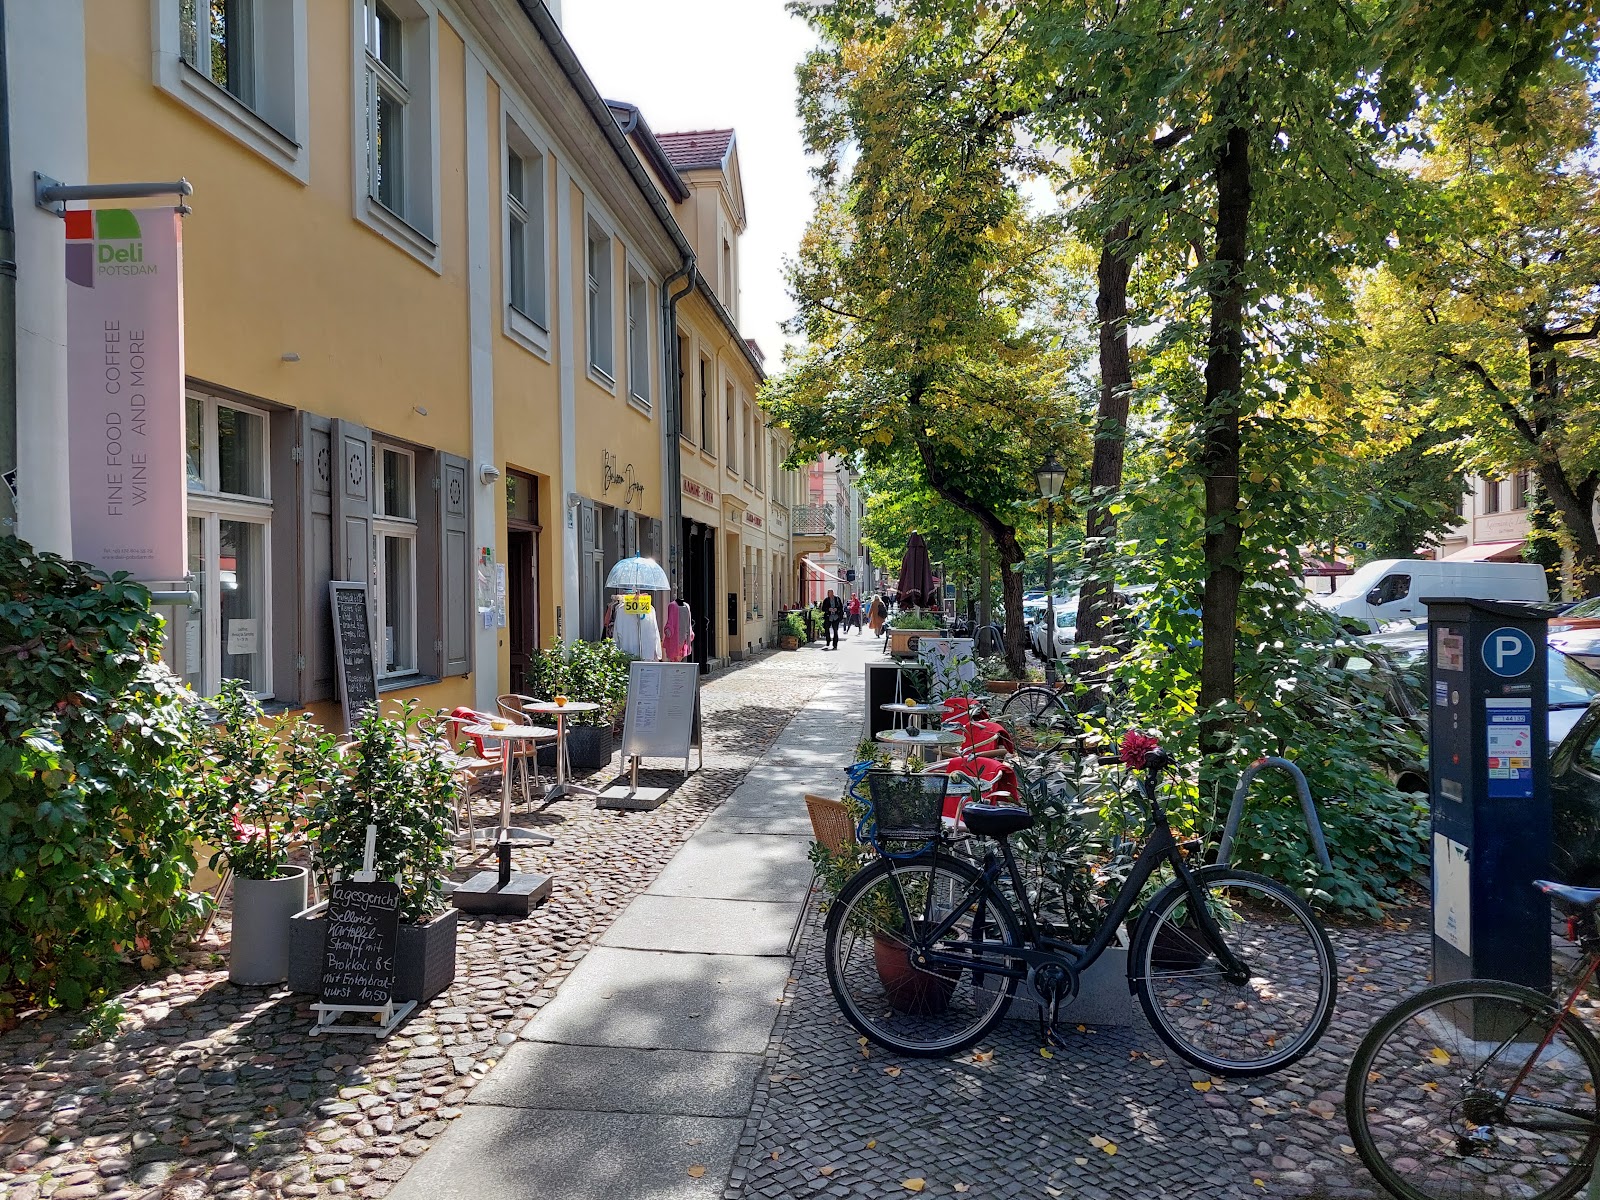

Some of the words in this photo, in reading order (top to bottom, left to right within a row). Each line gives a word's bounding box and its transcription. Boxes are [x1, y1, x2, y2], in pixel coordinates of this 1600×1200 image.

[98, 243, 142, 263] Deli
[98, 265, 158, 276] POTSDAM
[105, 320, 121, 394] COFFEE
[129, 330, 145, 387] MORE
[130, 394, 146, 436] AND
[106, 412, 122, 466] FOOD
[131, 454, 147, 506] WINE
[107, 474, 122, 516] FINE
[625, 601, 638, 611] 50
[640, 601, 650, 611] %
[1496, 636, 1522, 668] P
[332, 884, 400, 910] Tagesgericht
[327, 953, 372, 971] Brokkoli
[328, 938, 365, 959] Stampf
[366, 940, 383, 952] mit
[358, 987, 388, 1001] 10,50
